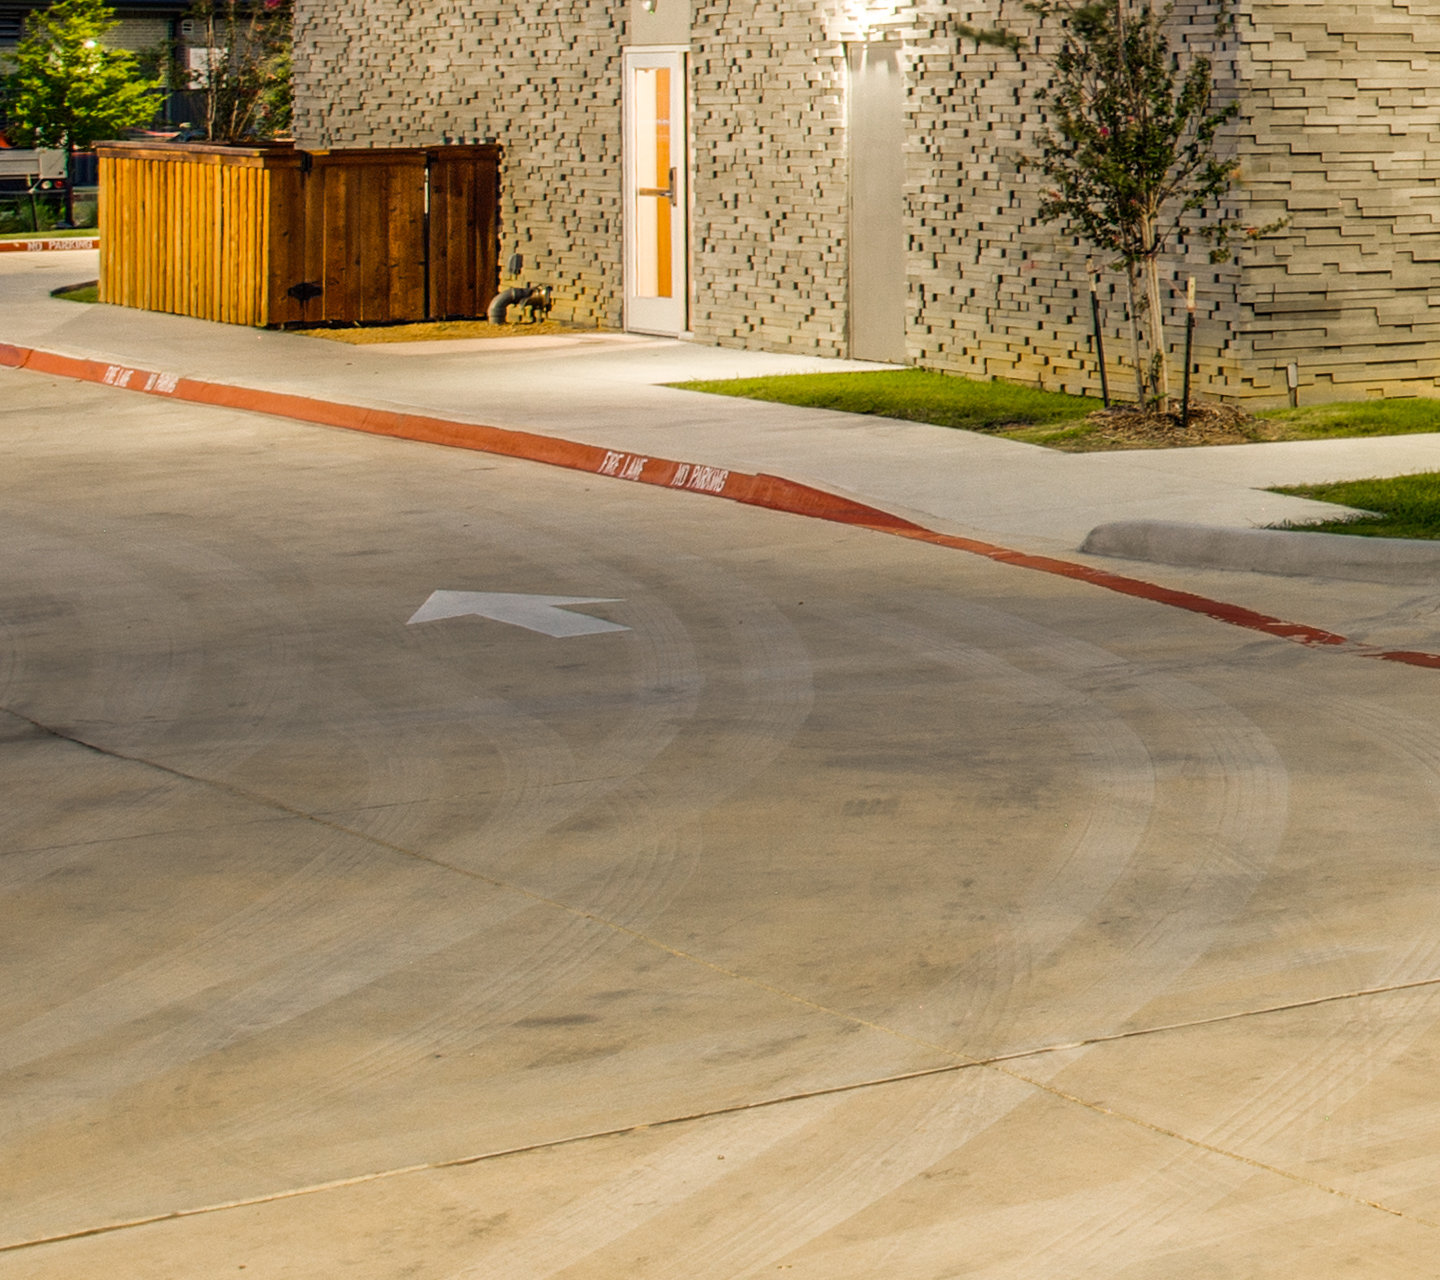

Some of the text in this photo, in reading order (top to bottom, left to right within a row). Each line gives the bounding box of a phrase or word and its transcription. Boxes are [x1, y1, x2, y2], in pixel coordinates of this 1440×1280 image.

[27, 240, 93, 251] NO PARKING
[597, 450, 730, 493] FIRE LANE NO PARKING
